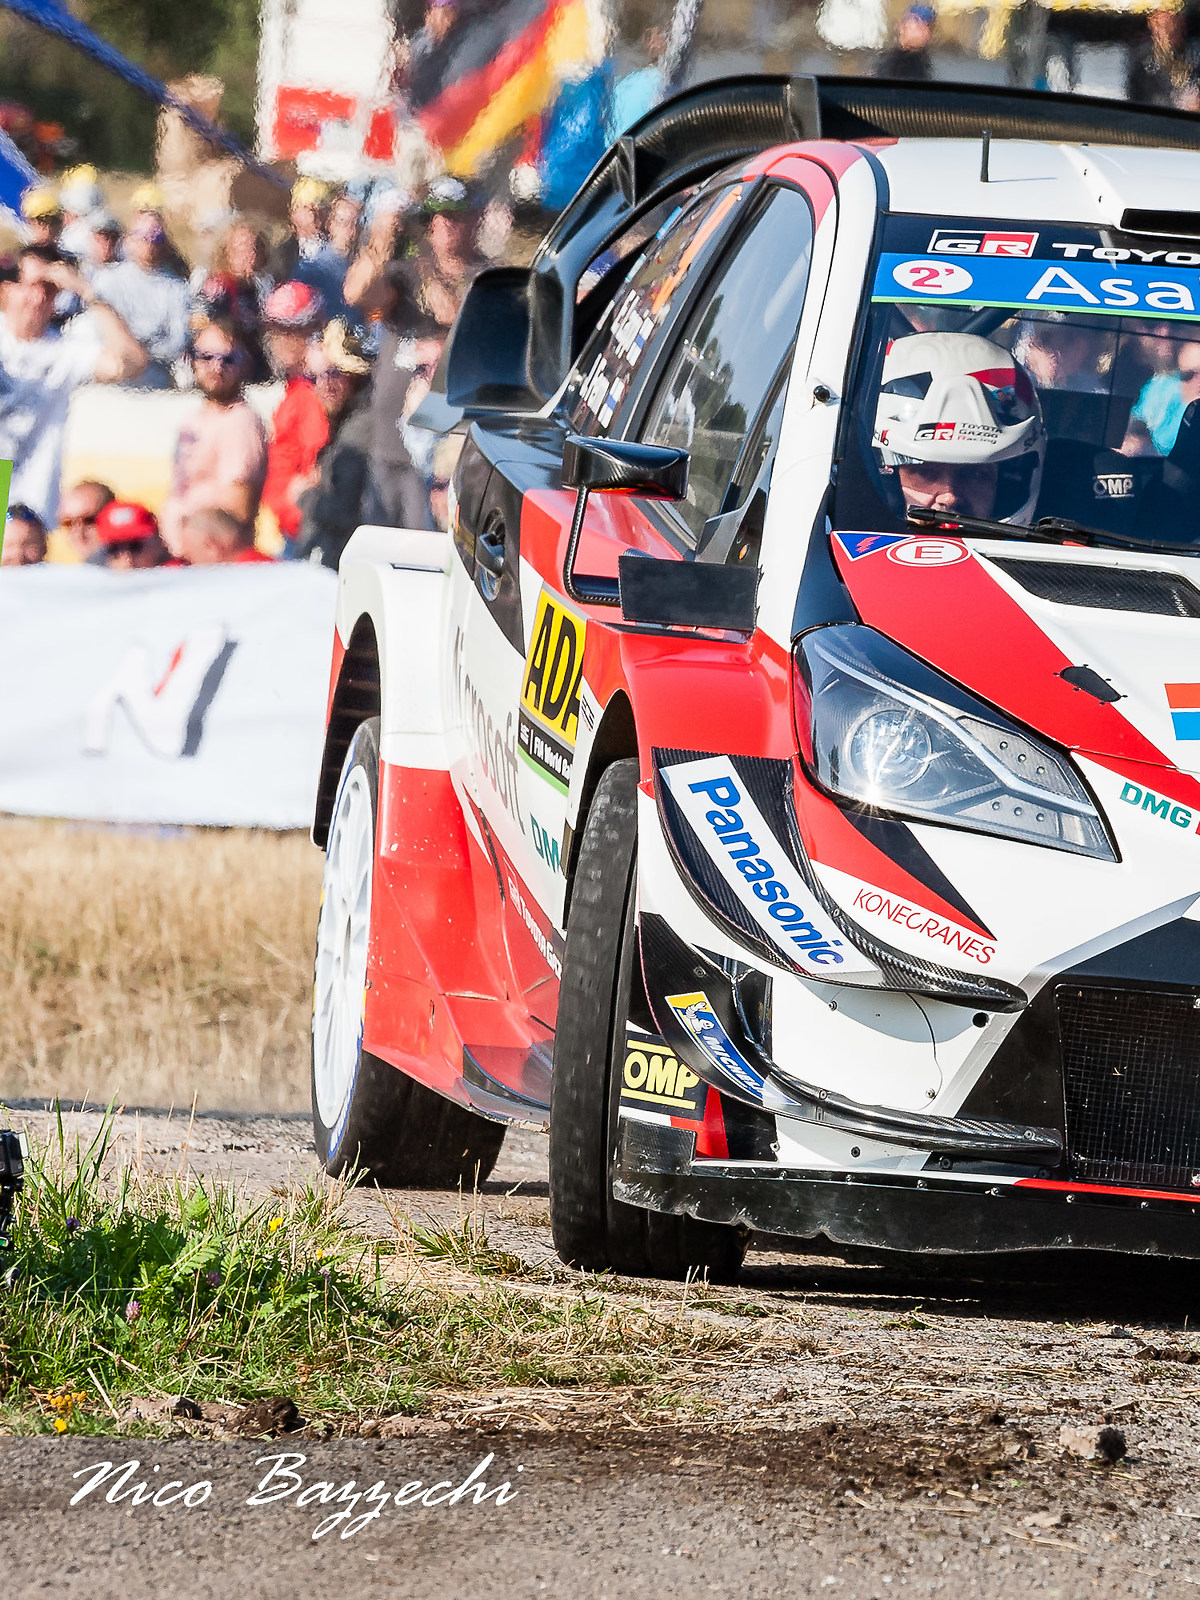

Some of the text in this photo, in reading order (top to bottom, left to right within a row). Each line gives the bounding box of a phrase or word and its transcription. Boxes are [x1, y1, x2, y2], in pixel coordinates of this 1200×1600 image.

[933, 236, 1032, 256] GR
[914, 426, 955, 441] GR
[914, 545, 944, 559] E
[1120, 782, 1192, 831] DMG
[688, 775, 844, 966] Panasonic
[853, 888, 996, 964] KONECRANES
[623, 1050, 700, 1098] OMP
